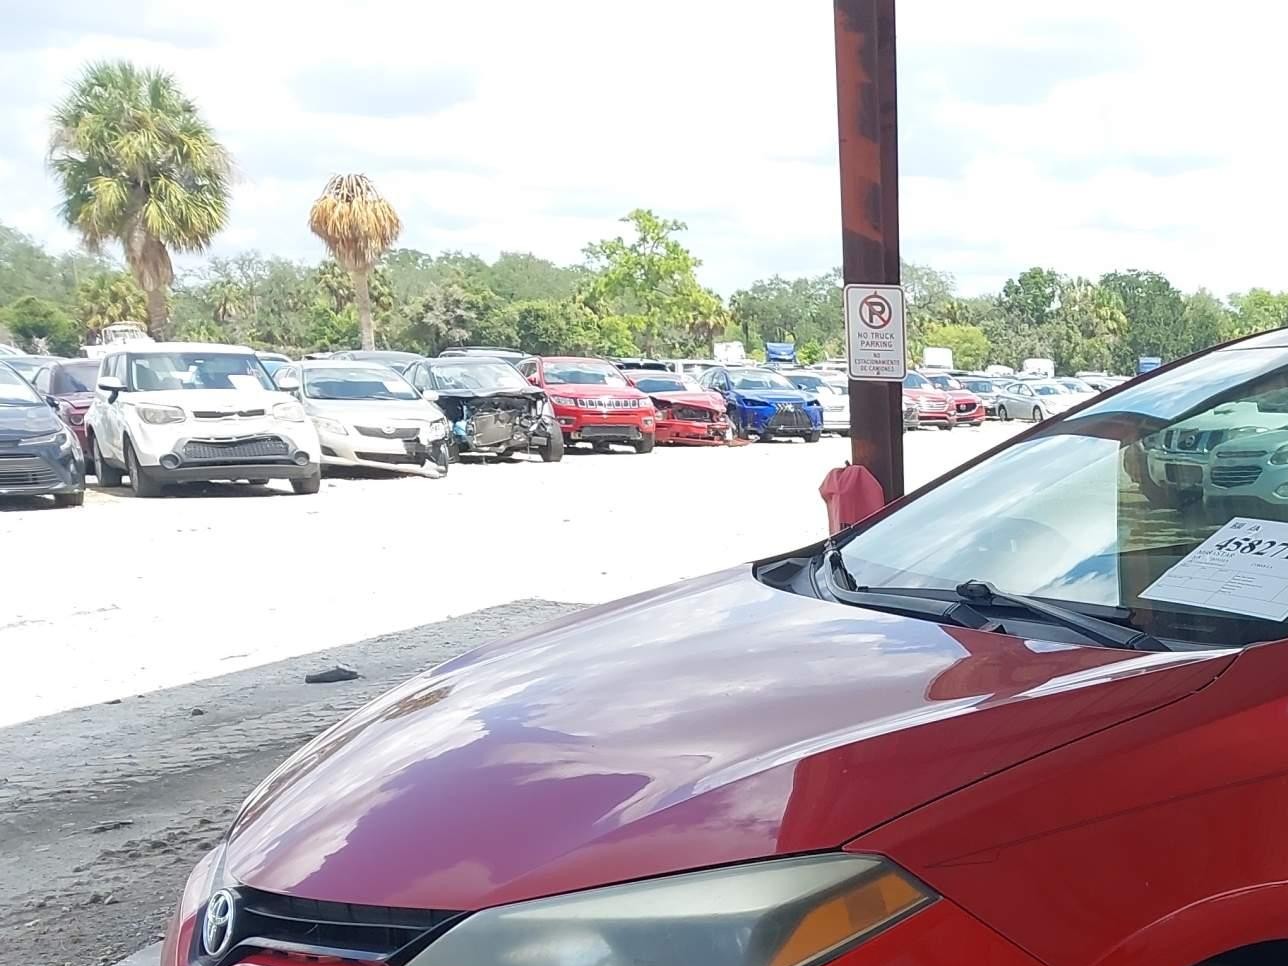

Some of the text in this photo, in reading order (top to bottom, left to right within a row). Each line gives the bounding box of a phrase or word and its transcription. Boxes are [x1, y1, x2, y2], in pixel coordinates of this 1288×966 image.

[857, 331, 895, 340] NO TRUCK
[861, 340, 893, 348] PARKING
